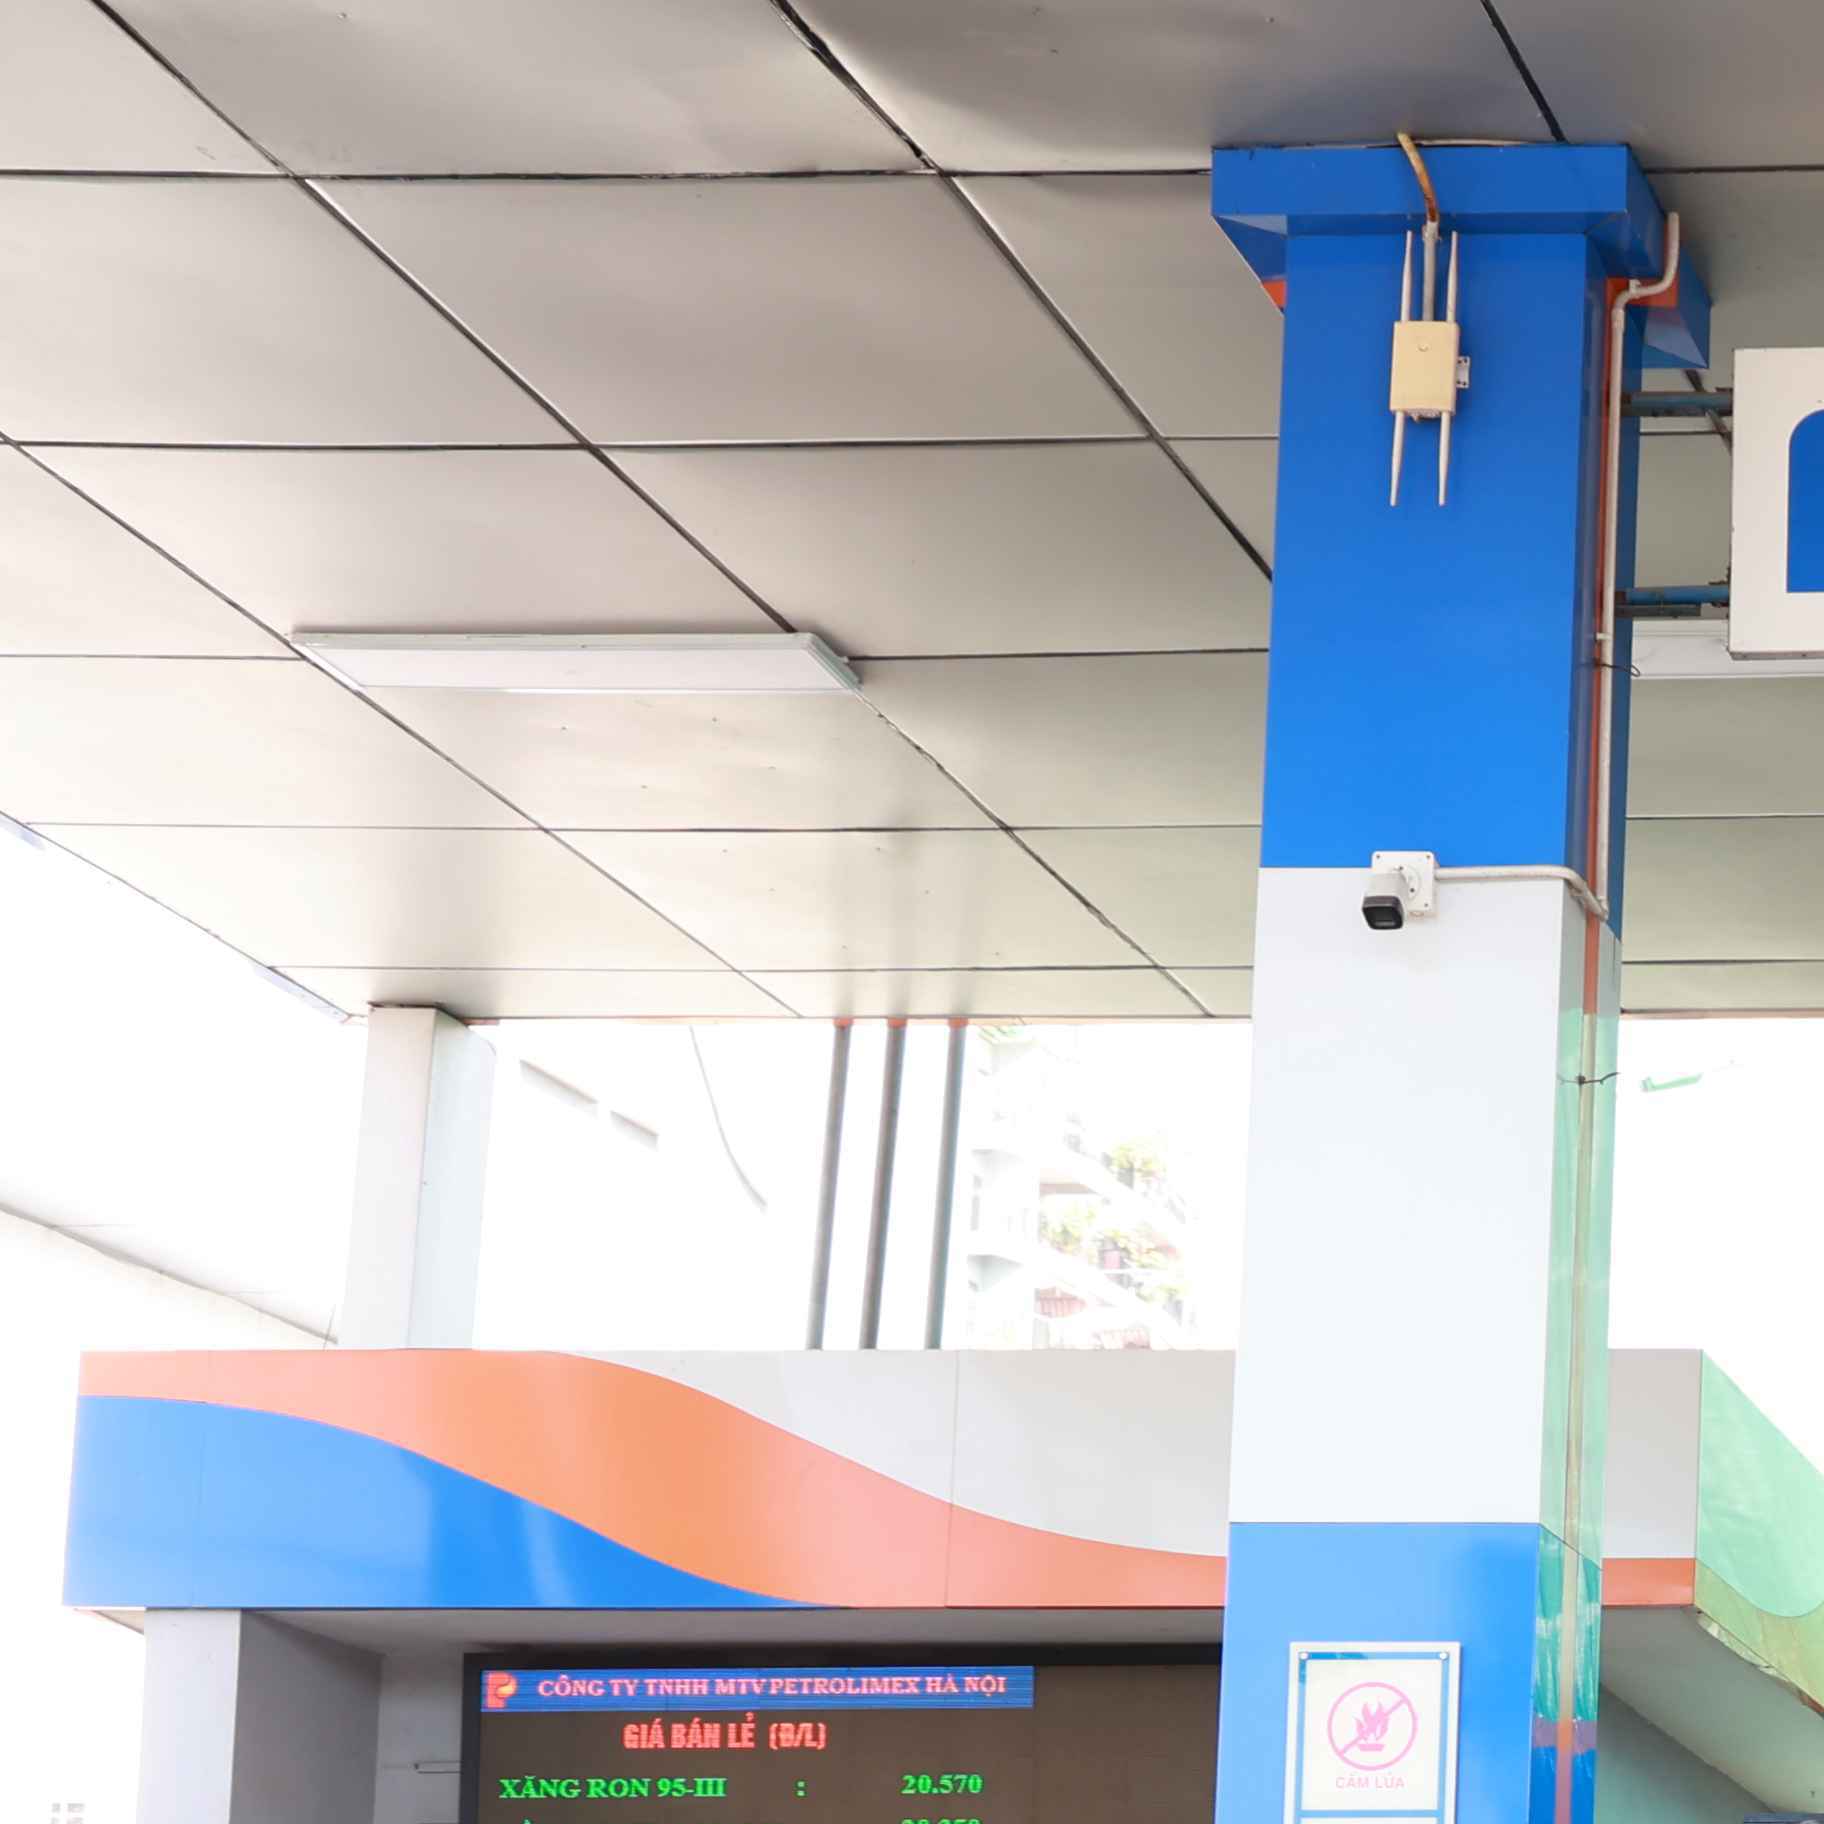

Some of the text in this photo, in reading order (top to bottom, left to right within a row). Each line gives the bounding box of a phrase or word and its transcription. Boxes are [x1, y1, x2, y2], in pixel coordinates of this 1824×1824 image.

[537, 1673, 1008, 1697] CÔNG TY TNHH MTV PETROLIMEX HÀ NỘI
[623, 1717, 666, 1749] GIÁ
[670, 1717, 721, 1749] BÁN
[727, 1711, 756, 1749] LẺ
[499, 1775, 582, 1799] XĂNG
[586, 1778, 651, 1798] RON
[656, 1777, 728, 1798] 95-III
[900, 1774, 984, 1795] 20.570
